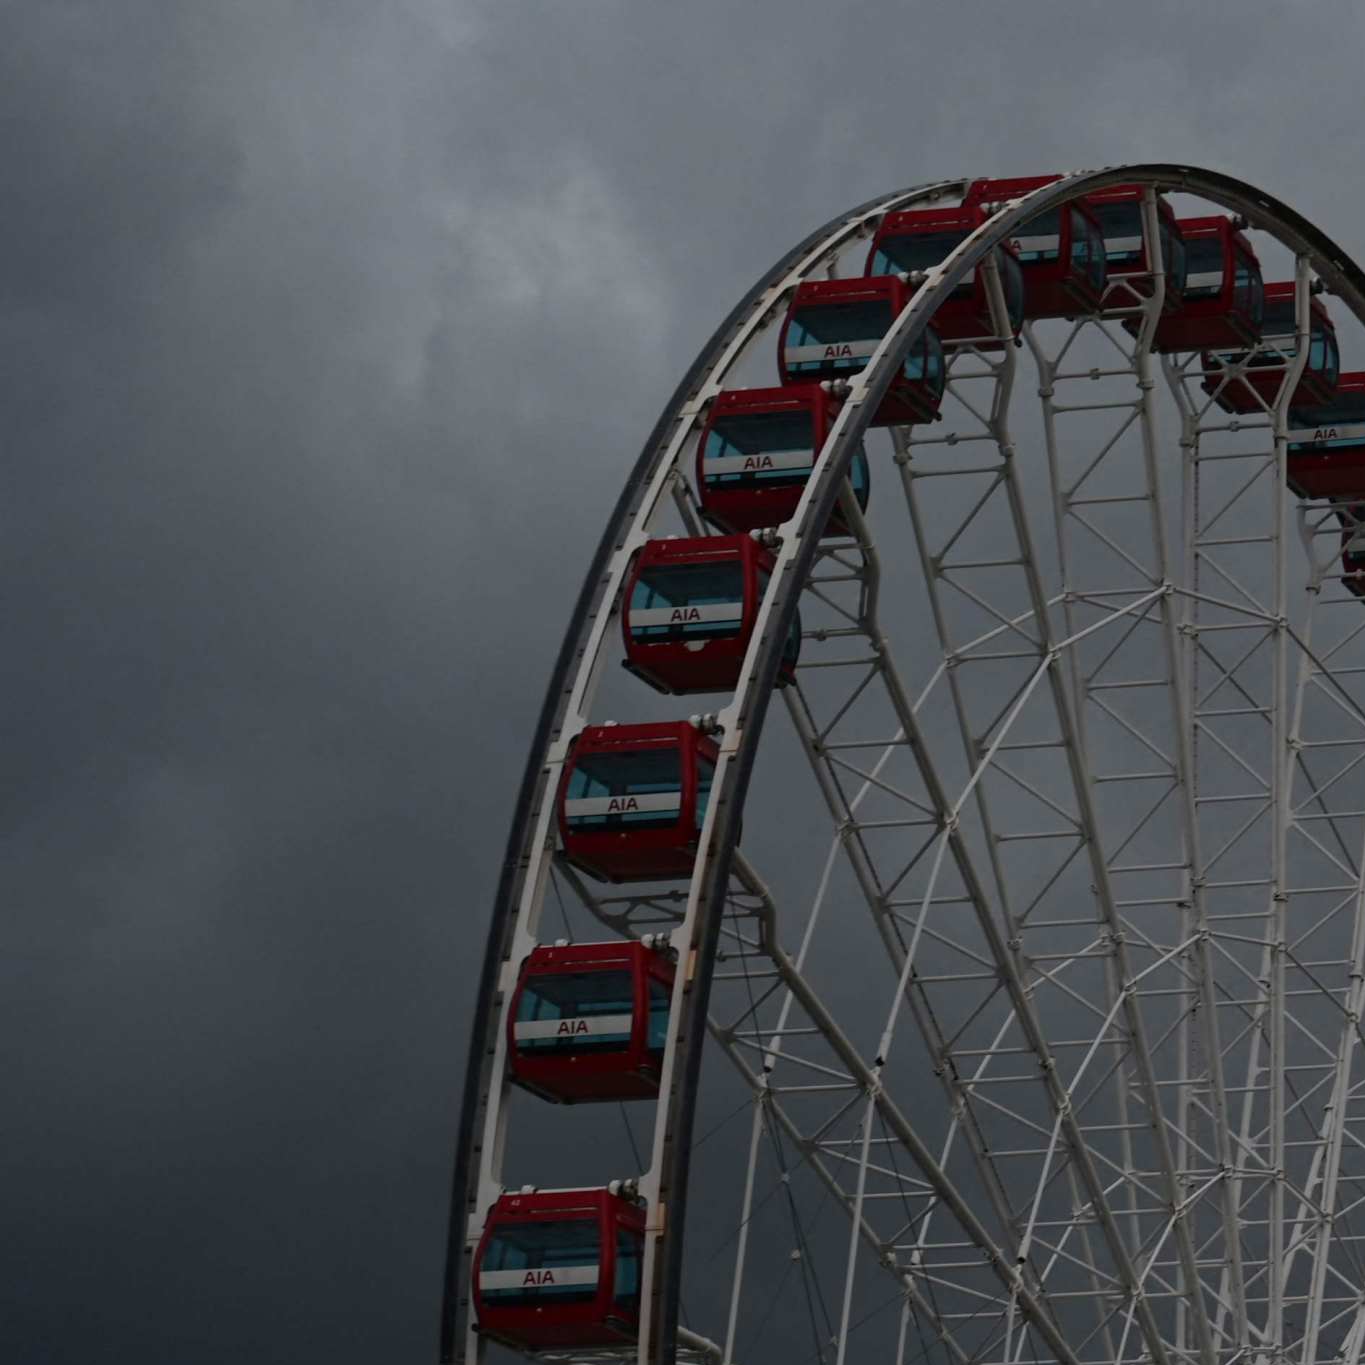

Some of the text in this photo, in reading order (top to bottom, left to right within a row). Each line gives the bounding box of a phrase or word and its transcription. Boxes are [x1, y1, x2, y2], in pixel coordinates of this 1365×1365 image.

[824, 345, 852, 358] AIA
[1314, 429, 1337, 439] AIA
[744, 456, 772, 470] AIA
[671, 608, 700, 621] AIA
[608, 798, 638, 811] AIA
[558, 1021, 588, 1034] AIA
[523, 1271, 555, 1285] AIA
